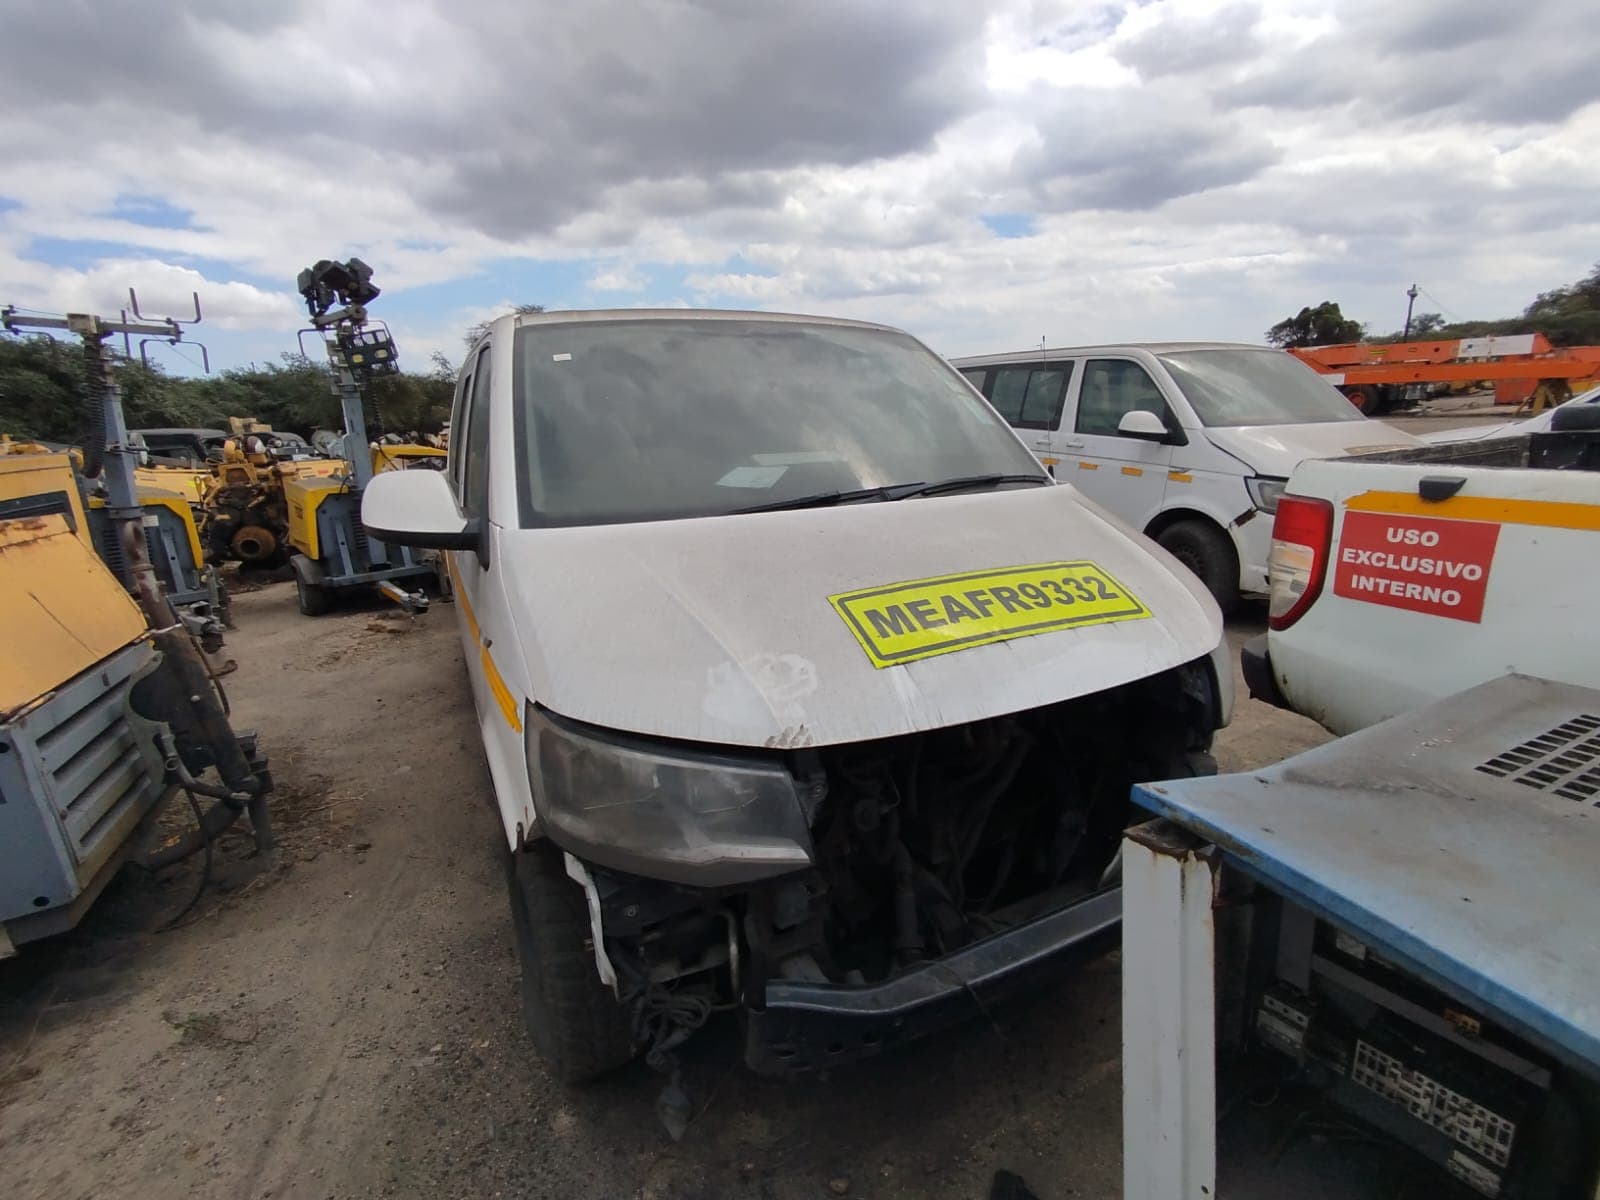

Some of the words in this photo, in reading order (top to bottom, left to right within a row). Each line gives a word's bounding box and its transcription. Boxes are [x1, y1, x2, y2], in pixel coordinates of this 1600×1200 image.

[1386, 527, 1440, 547] USO
[1342, 548, 1482, 581] EXCLUSIVO
[1351, 574, 1461, 606] INTERNO
[864, 575, 1120, 639] MEAFR9332
